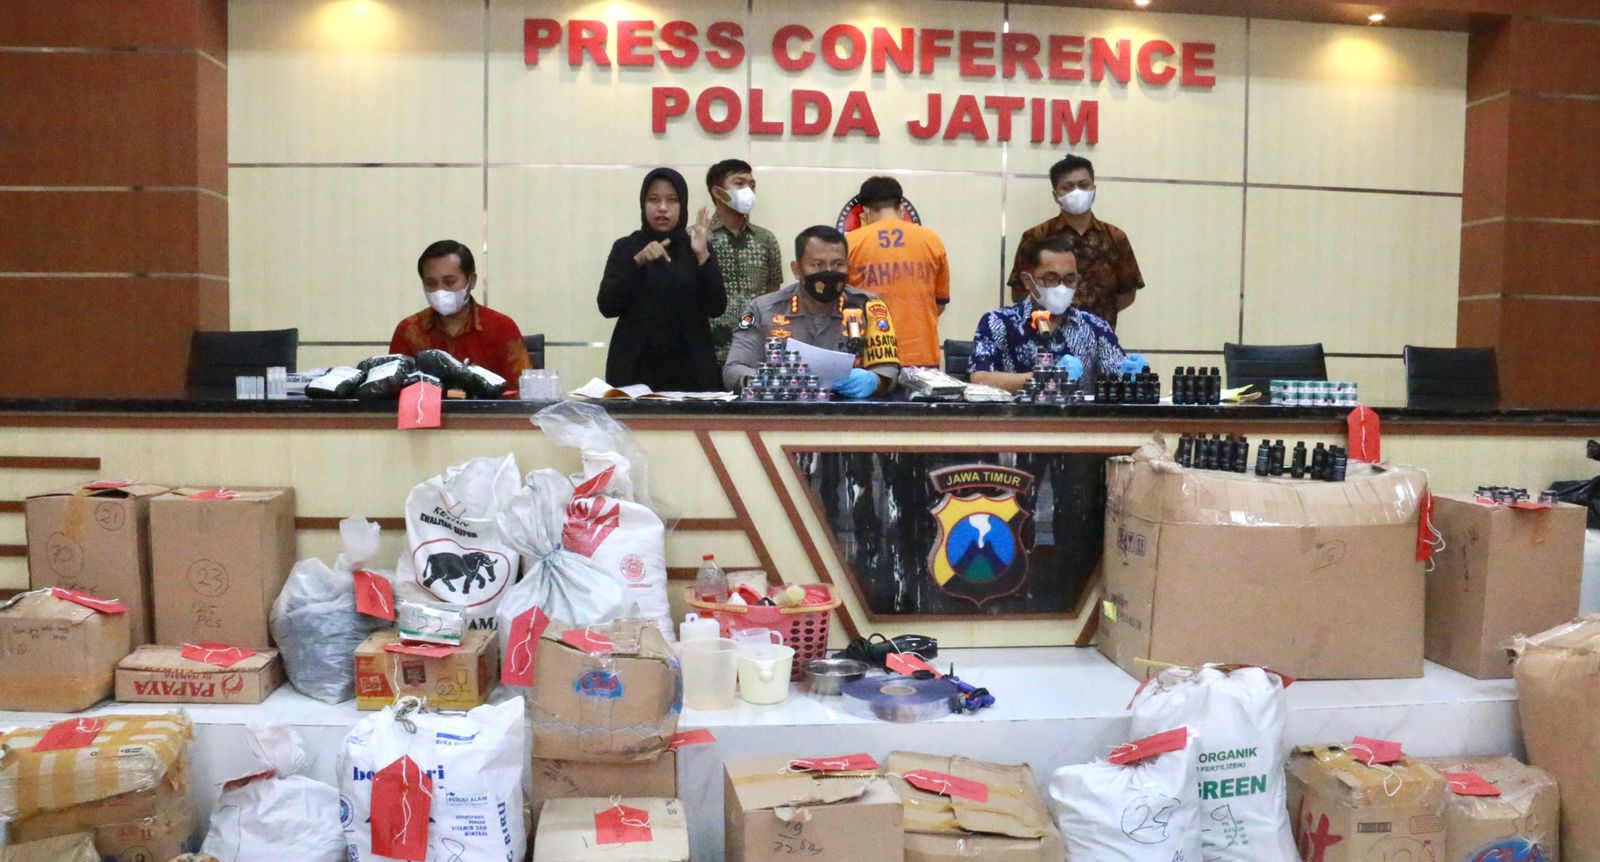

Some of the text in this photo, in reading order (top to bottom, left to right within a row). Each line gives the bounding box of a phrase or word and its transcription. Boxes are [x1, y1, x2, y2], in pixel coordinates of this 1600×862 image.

[523, 18, 1217, 88] PRESS CONFERENCE
[651, 86, 1099, 146] POLDA JATIM
[877, 228, 905, 249] 52
[947, 471, 1021, 487] JAWA TIMUR
[198, 567, 225, 589] 23
[133, 680, 216, 698] PAPAYA
[1198, 747, 1258, 763] ORGANIK
[1197, 774, 1268, 800] REEN
